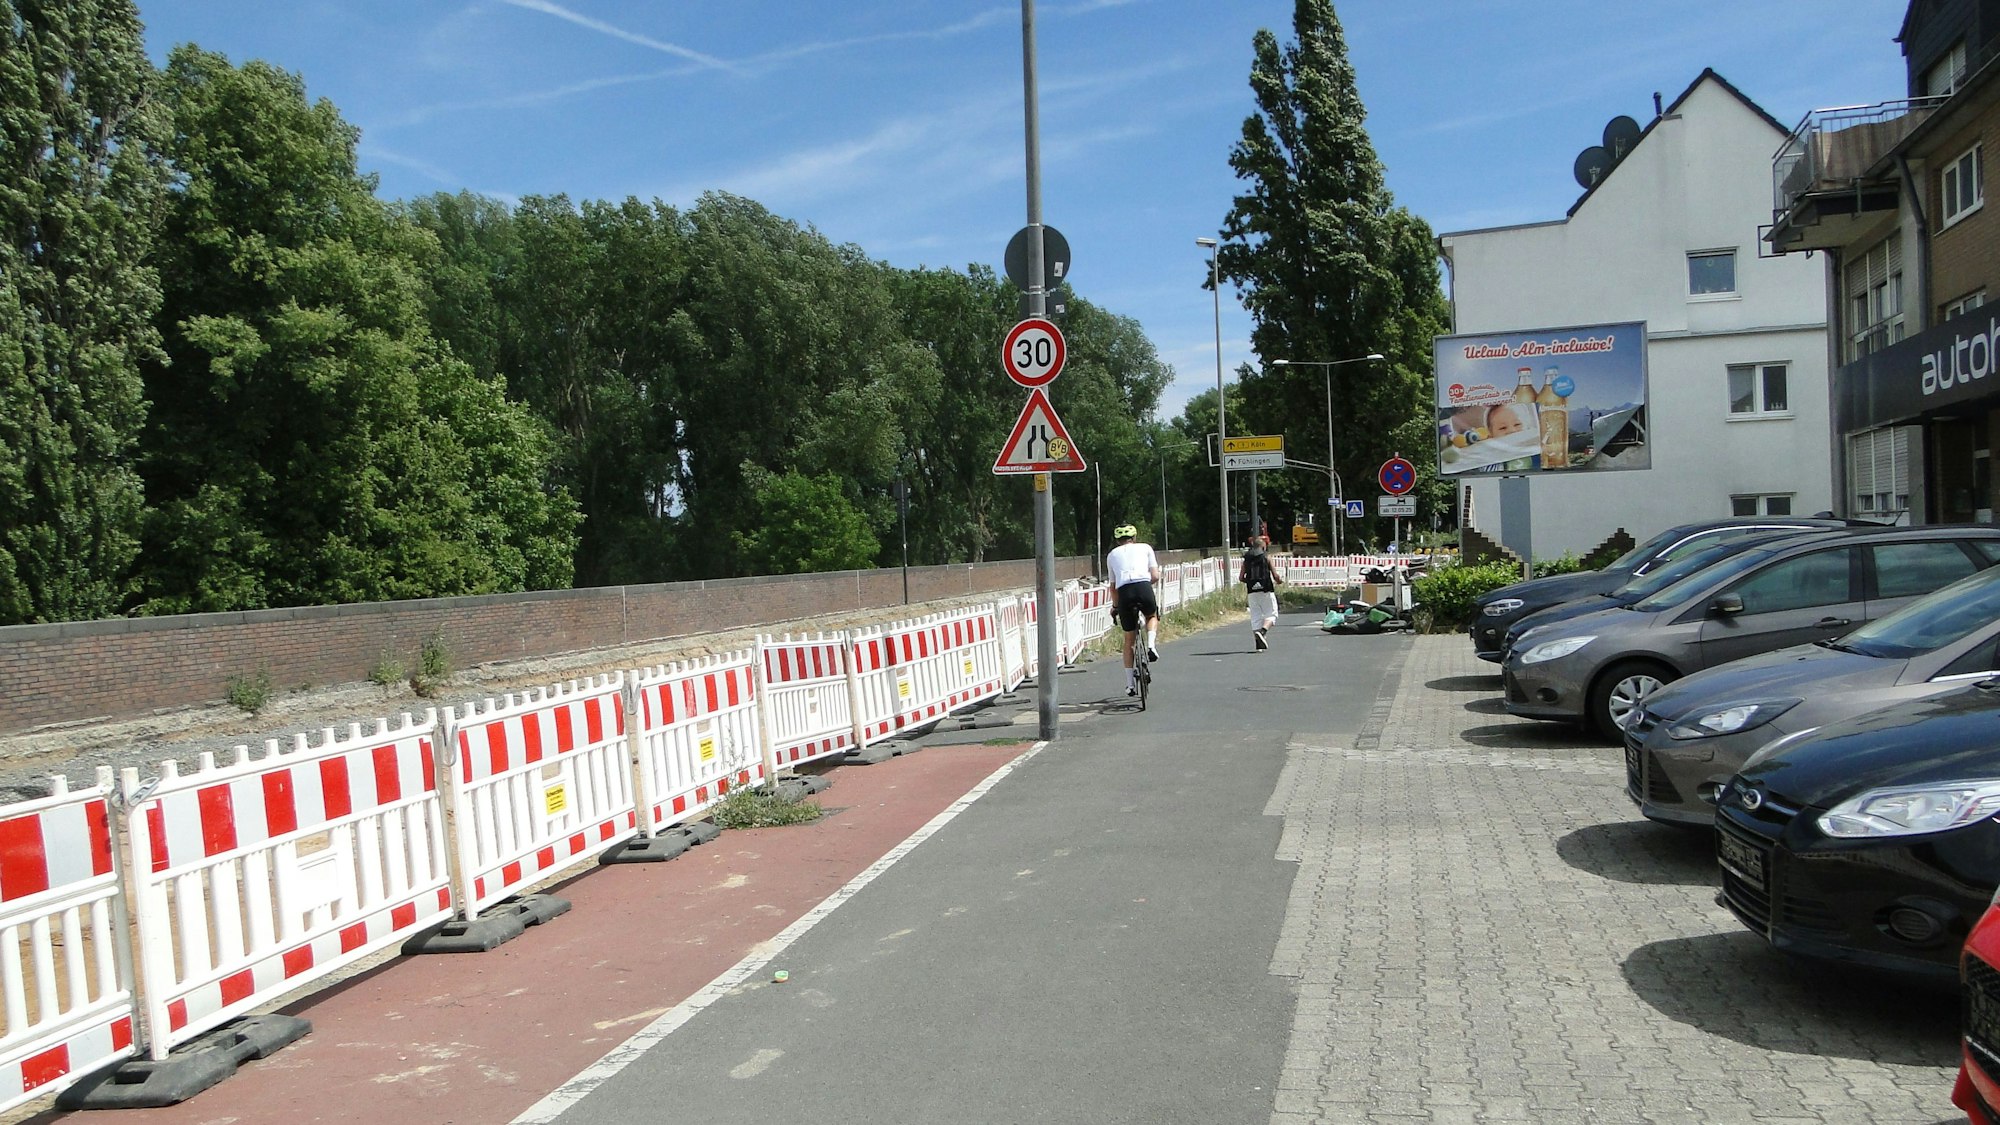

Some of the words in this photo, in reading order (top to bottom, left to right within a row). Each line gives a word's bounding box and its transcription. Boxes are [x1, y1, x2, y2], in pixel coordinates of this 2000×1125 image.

[1016, 337, 1051, 369] 30
[1463, 344, 1509, 359] Urlaub
[1512, 336, 1613, 358] Alm-inclusive!
[1050, 440, 1067, 454] BVB
[1238, 457, 1271, 465] Fühlingen
